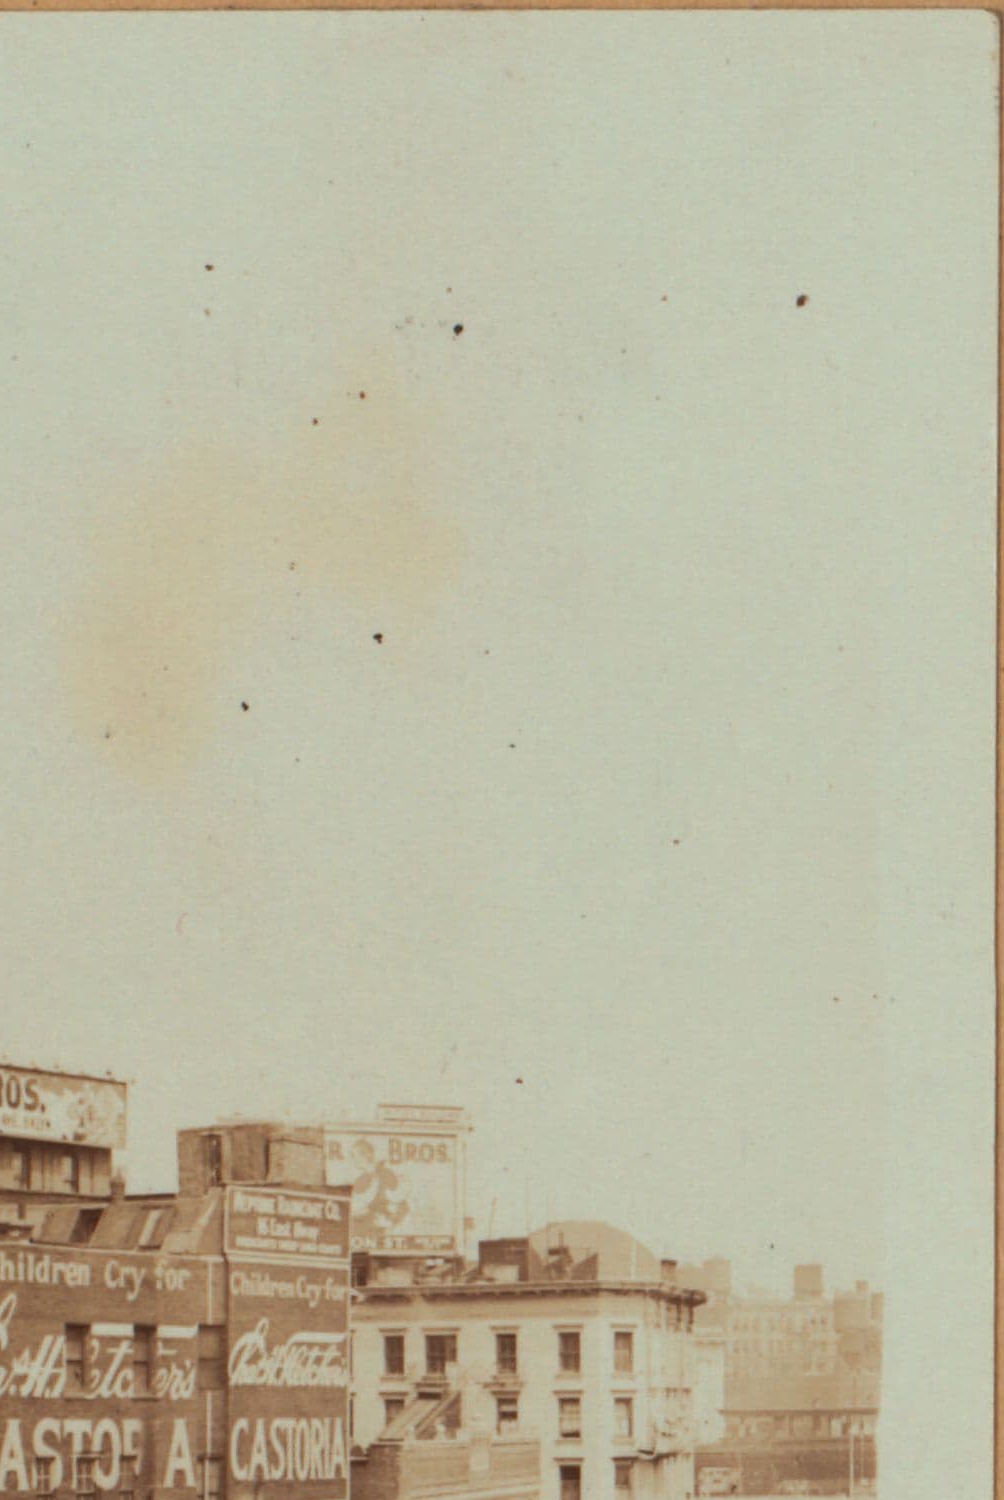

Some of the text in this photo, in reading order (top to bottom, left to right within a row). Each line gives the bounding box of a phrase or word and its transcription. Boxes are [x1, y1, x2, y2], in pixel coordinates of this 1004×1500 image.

[104, 1259, 145, 1302] Cry
[155, 1257, 192, 1291] for
[230, 1270, 347, 1309] Children Cry for
[230, 1416, 348, 1481] CASTORIA
